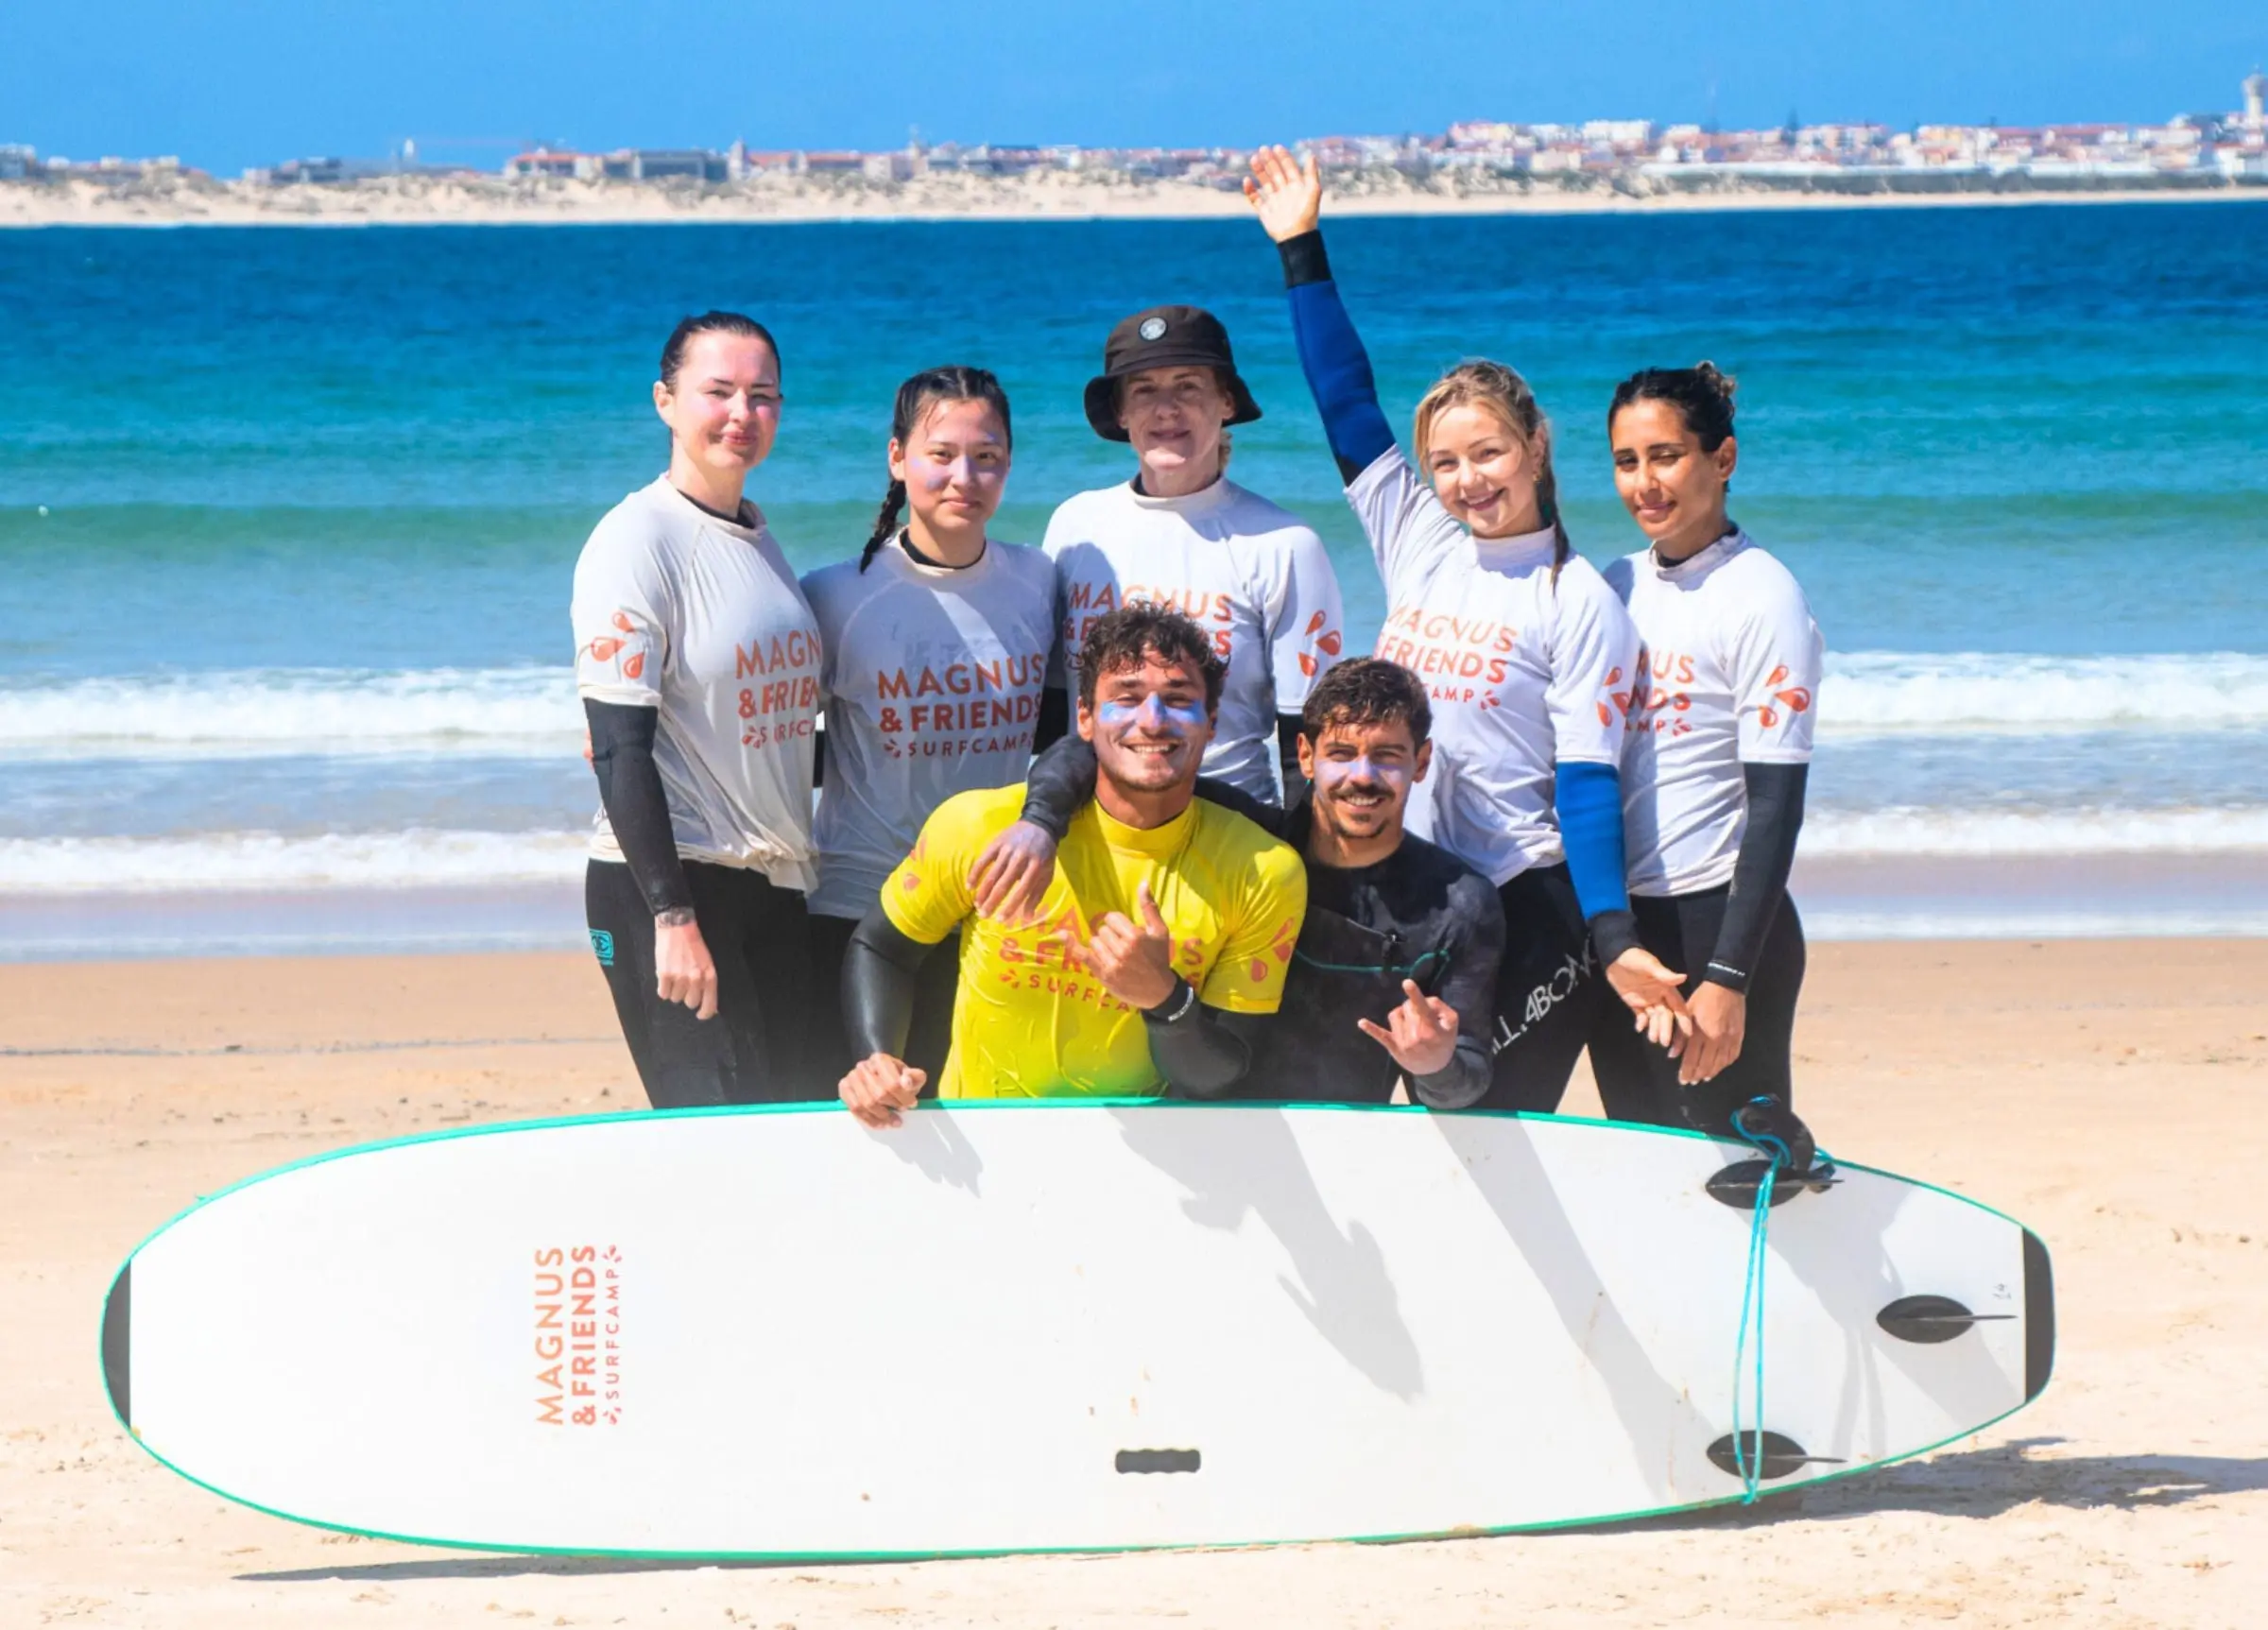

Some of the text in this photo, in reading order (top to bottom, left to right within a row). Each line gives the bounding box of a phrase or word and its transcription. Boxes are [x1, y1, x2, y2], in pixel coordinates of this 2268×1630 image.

[878, 653, 1044, 700] MAGNUS
[1381, 635, 1508, 684] FRIENDS
[738, 688, 757, 718] &
[880, 707, 902, 733] &
[1000, 937, 1025, 963] &
[1030, 974, 1141, 1015] SURFCA
[534, 1247, 564, 1425] MAGNUS
[571, 1245, 595, 1425] & FRIENDS
[606, 1268, 620, 1399] SURFCAMP
